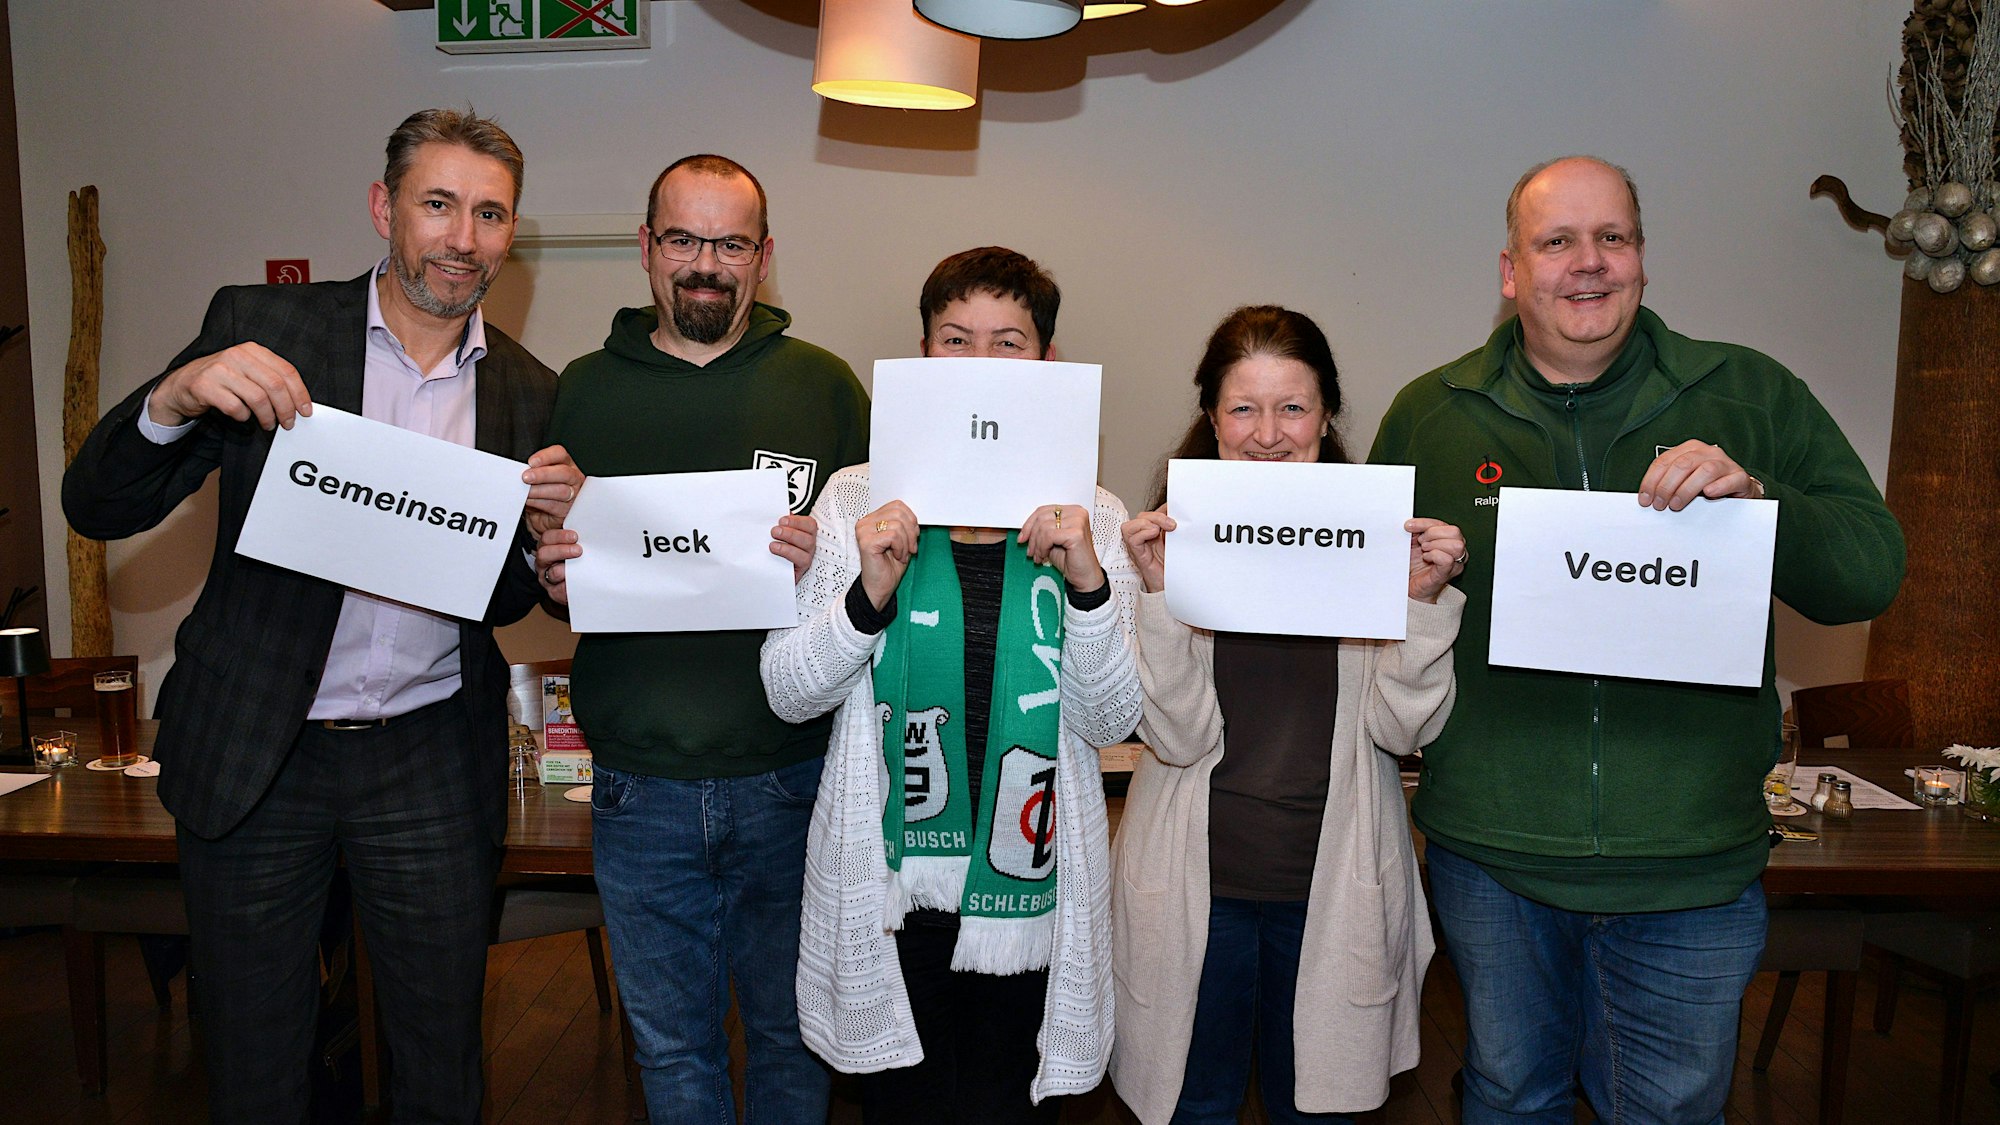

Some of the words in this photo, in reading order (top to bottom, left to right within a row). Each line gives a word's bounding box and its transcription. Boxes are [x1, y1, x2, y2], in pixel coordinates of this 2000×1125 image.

[971, 413, 999, 441] in
[288, 459, 498, 541] Gemeinsam
[642, 528, 711, 559] jeck
[1214, 523, 1366, 549] unserem
[1564, 550, 1699, 588] Veedel
[904, 830, 966, 849] BUSCH
